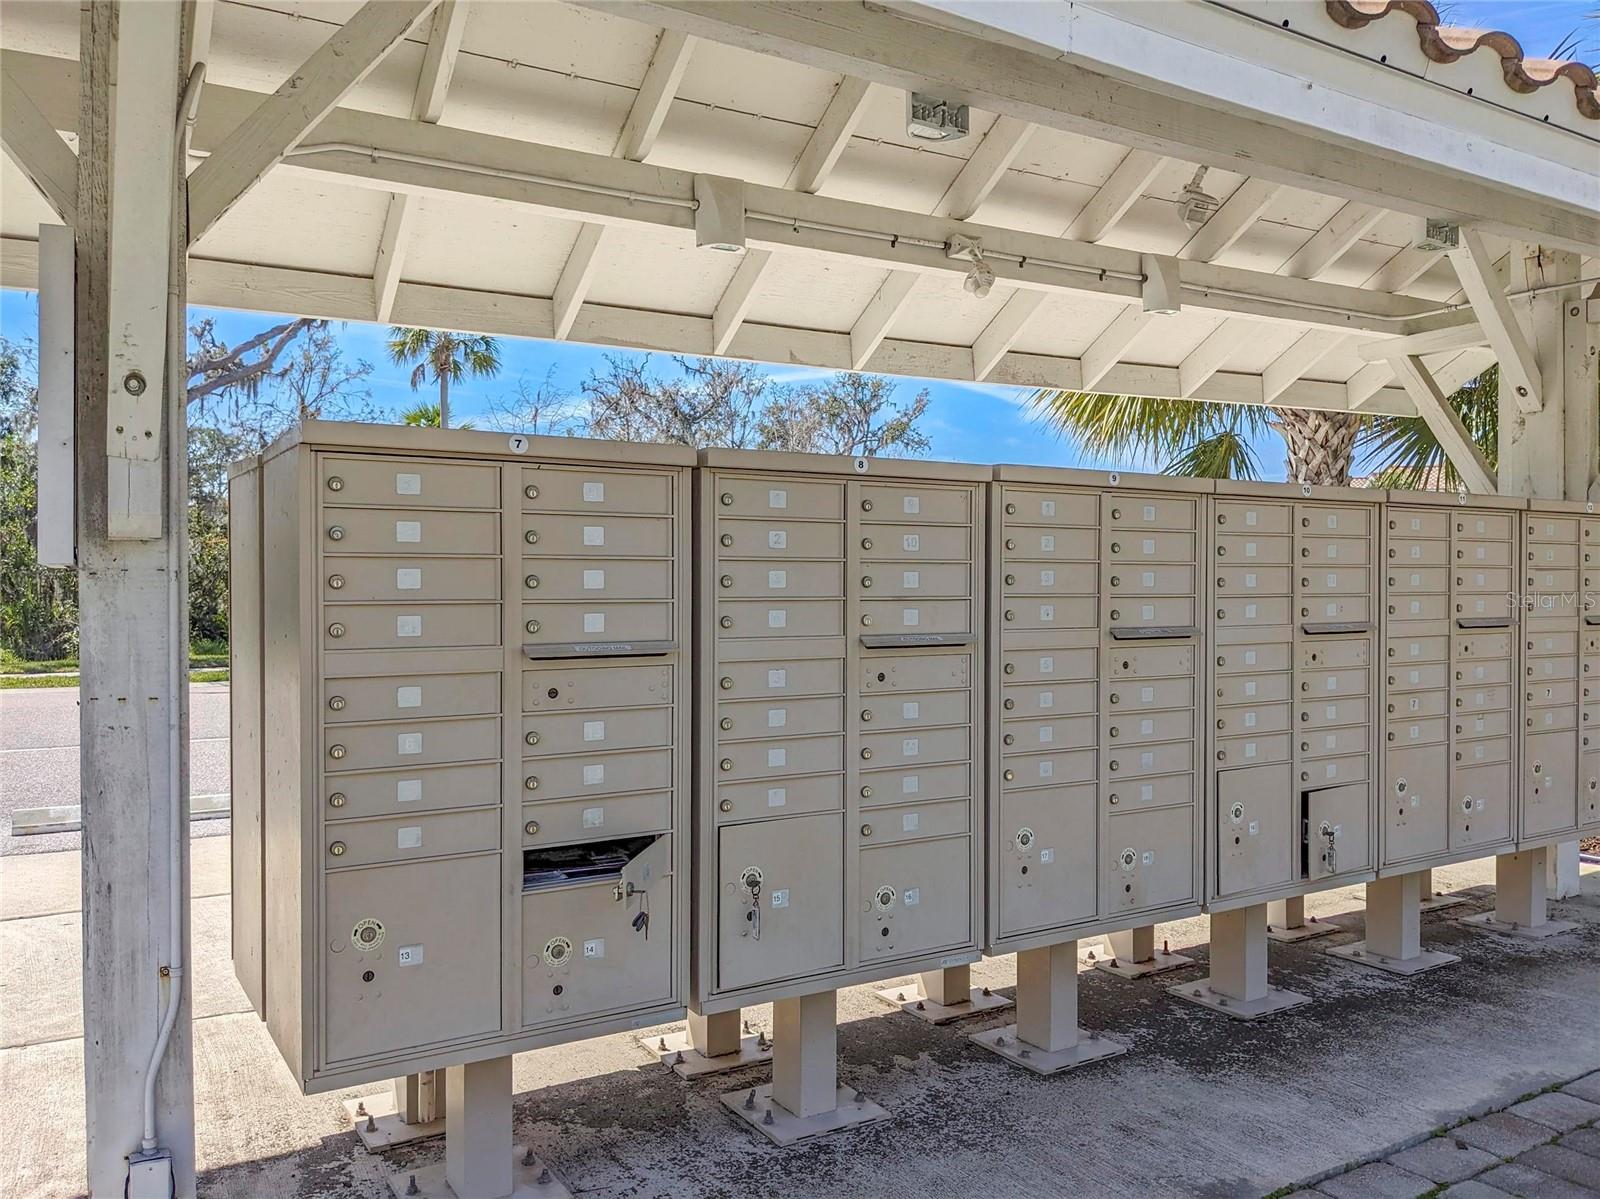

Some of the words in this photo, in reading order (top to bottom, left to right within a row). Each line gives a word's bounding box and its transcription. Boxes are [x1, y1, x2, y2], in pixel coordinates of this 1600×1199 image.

[514, 440, 522, 449] 7
[858, 460, 864, 469] 8
[1112, 474, 1117, 482] 9
[774, 533, 781, 545] 2
[905, 536, 917, 548] 10
[773, 894, 781, 902] 15
[358, 919, 377, 930] OPEN
[550, 938, 567, 947] OPEN
[586, 946, 594, 954] 14
[400, 951, 410, 960] 13
